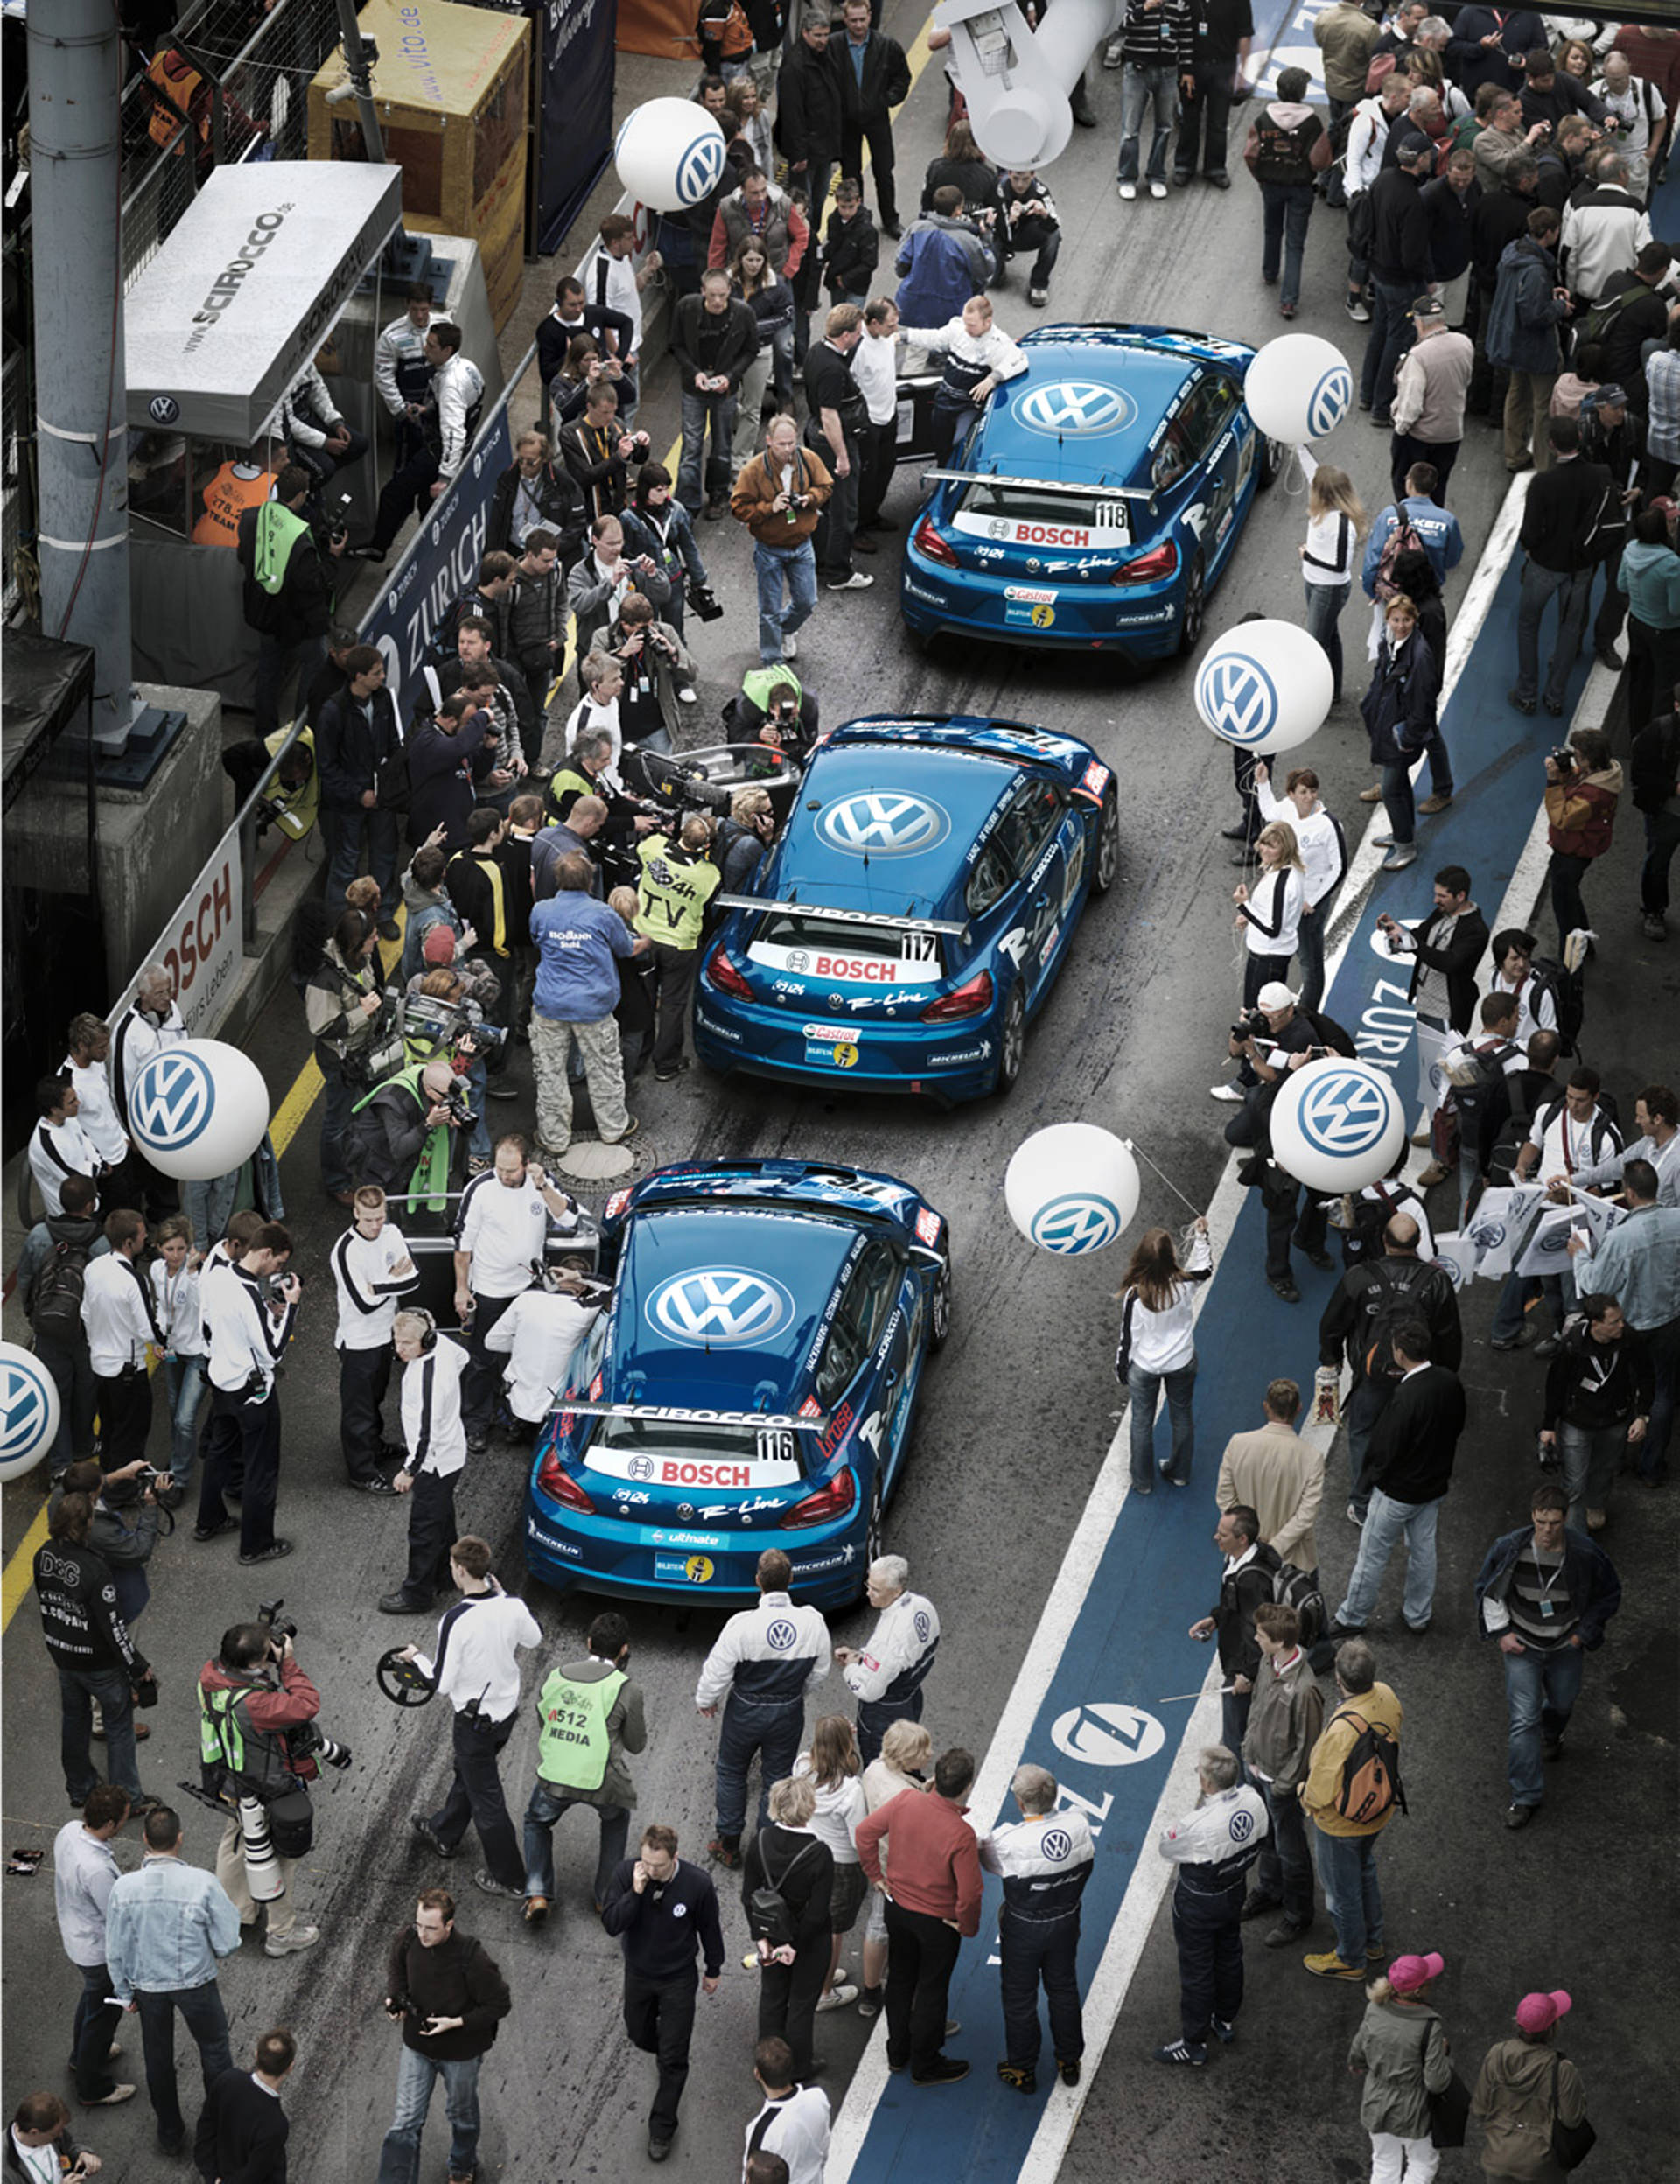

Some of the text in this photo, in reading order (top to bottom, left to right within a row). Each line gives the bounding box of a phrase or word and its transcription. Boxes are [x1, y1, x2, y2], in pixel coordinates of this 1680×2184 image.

[396, 7, 443, 101] www.vito.de
[1096, 502, 1126, 528] 118
[1015, 524, 1089, 547] BOSCH
[1044, 555, 1119, 573] R-Line
[407, 499, 487, 679] ZURICH
[1015, 590, 1054, 602] Castrol
[1119, 612, 1166, 624] MICHELIN
[643, 887, 687, 928] TV
[902, 934, 936, 961] 117
[816, 956, 896, 981] BOSCH
[846, 990, 929, 1010] R-Line
[816, 1026, 858, 1042] Castrol
[1354, 977, 1419, 1069] ZURI
[929, 1049, 982, 1064] MICHELIN
[758, 1432, 793, 1460] 116
[662, 1461, 750, 1487] BOSCH
[698, 1496, 788, 1519] R-Line
[536, 1530, 579, 1556] MICHELIN
[668, 1533, 720, 1545] ultimate
[791, 1554, 844, 1572] MICHELIN
[556, 1709, 588, 1729] 512
[550, 1726, 591, 1746] MEDIA
